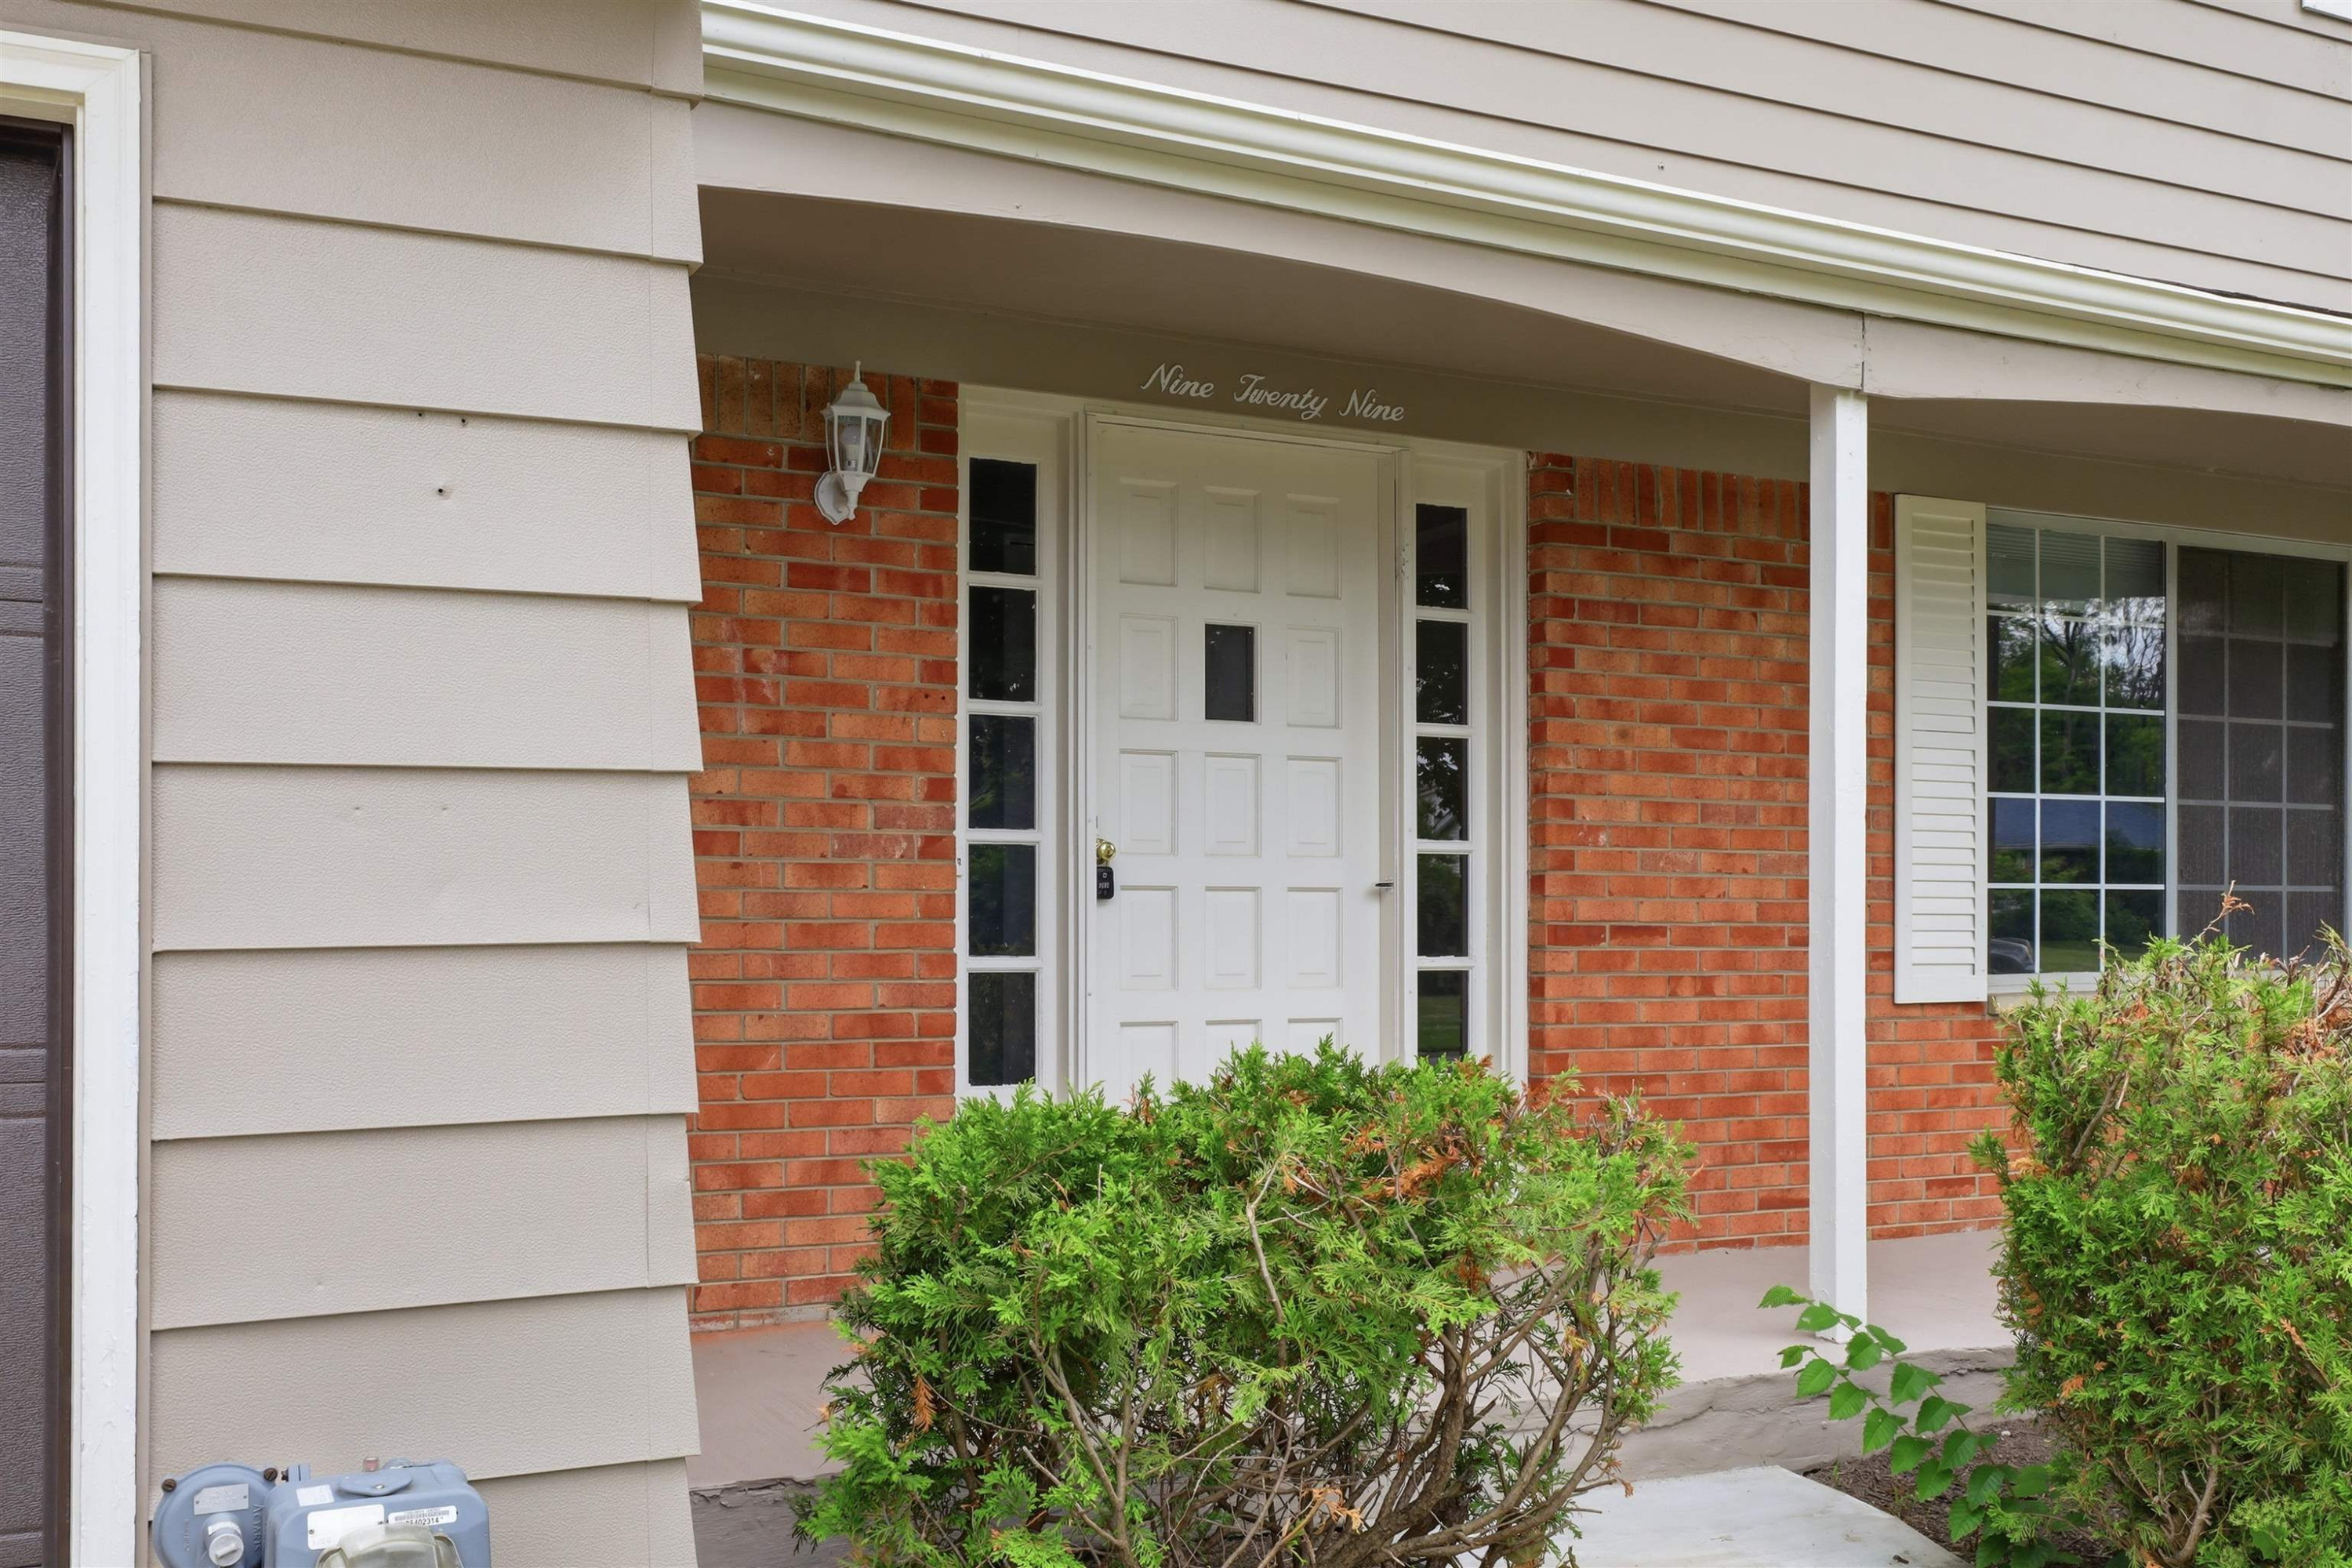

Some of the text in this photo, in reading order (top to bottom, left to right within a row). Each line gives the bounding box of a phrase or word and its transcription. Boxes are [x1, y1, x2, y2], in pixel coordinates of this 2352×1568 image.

[1140, 363, 1405, 421] Nine Twenty Nine
